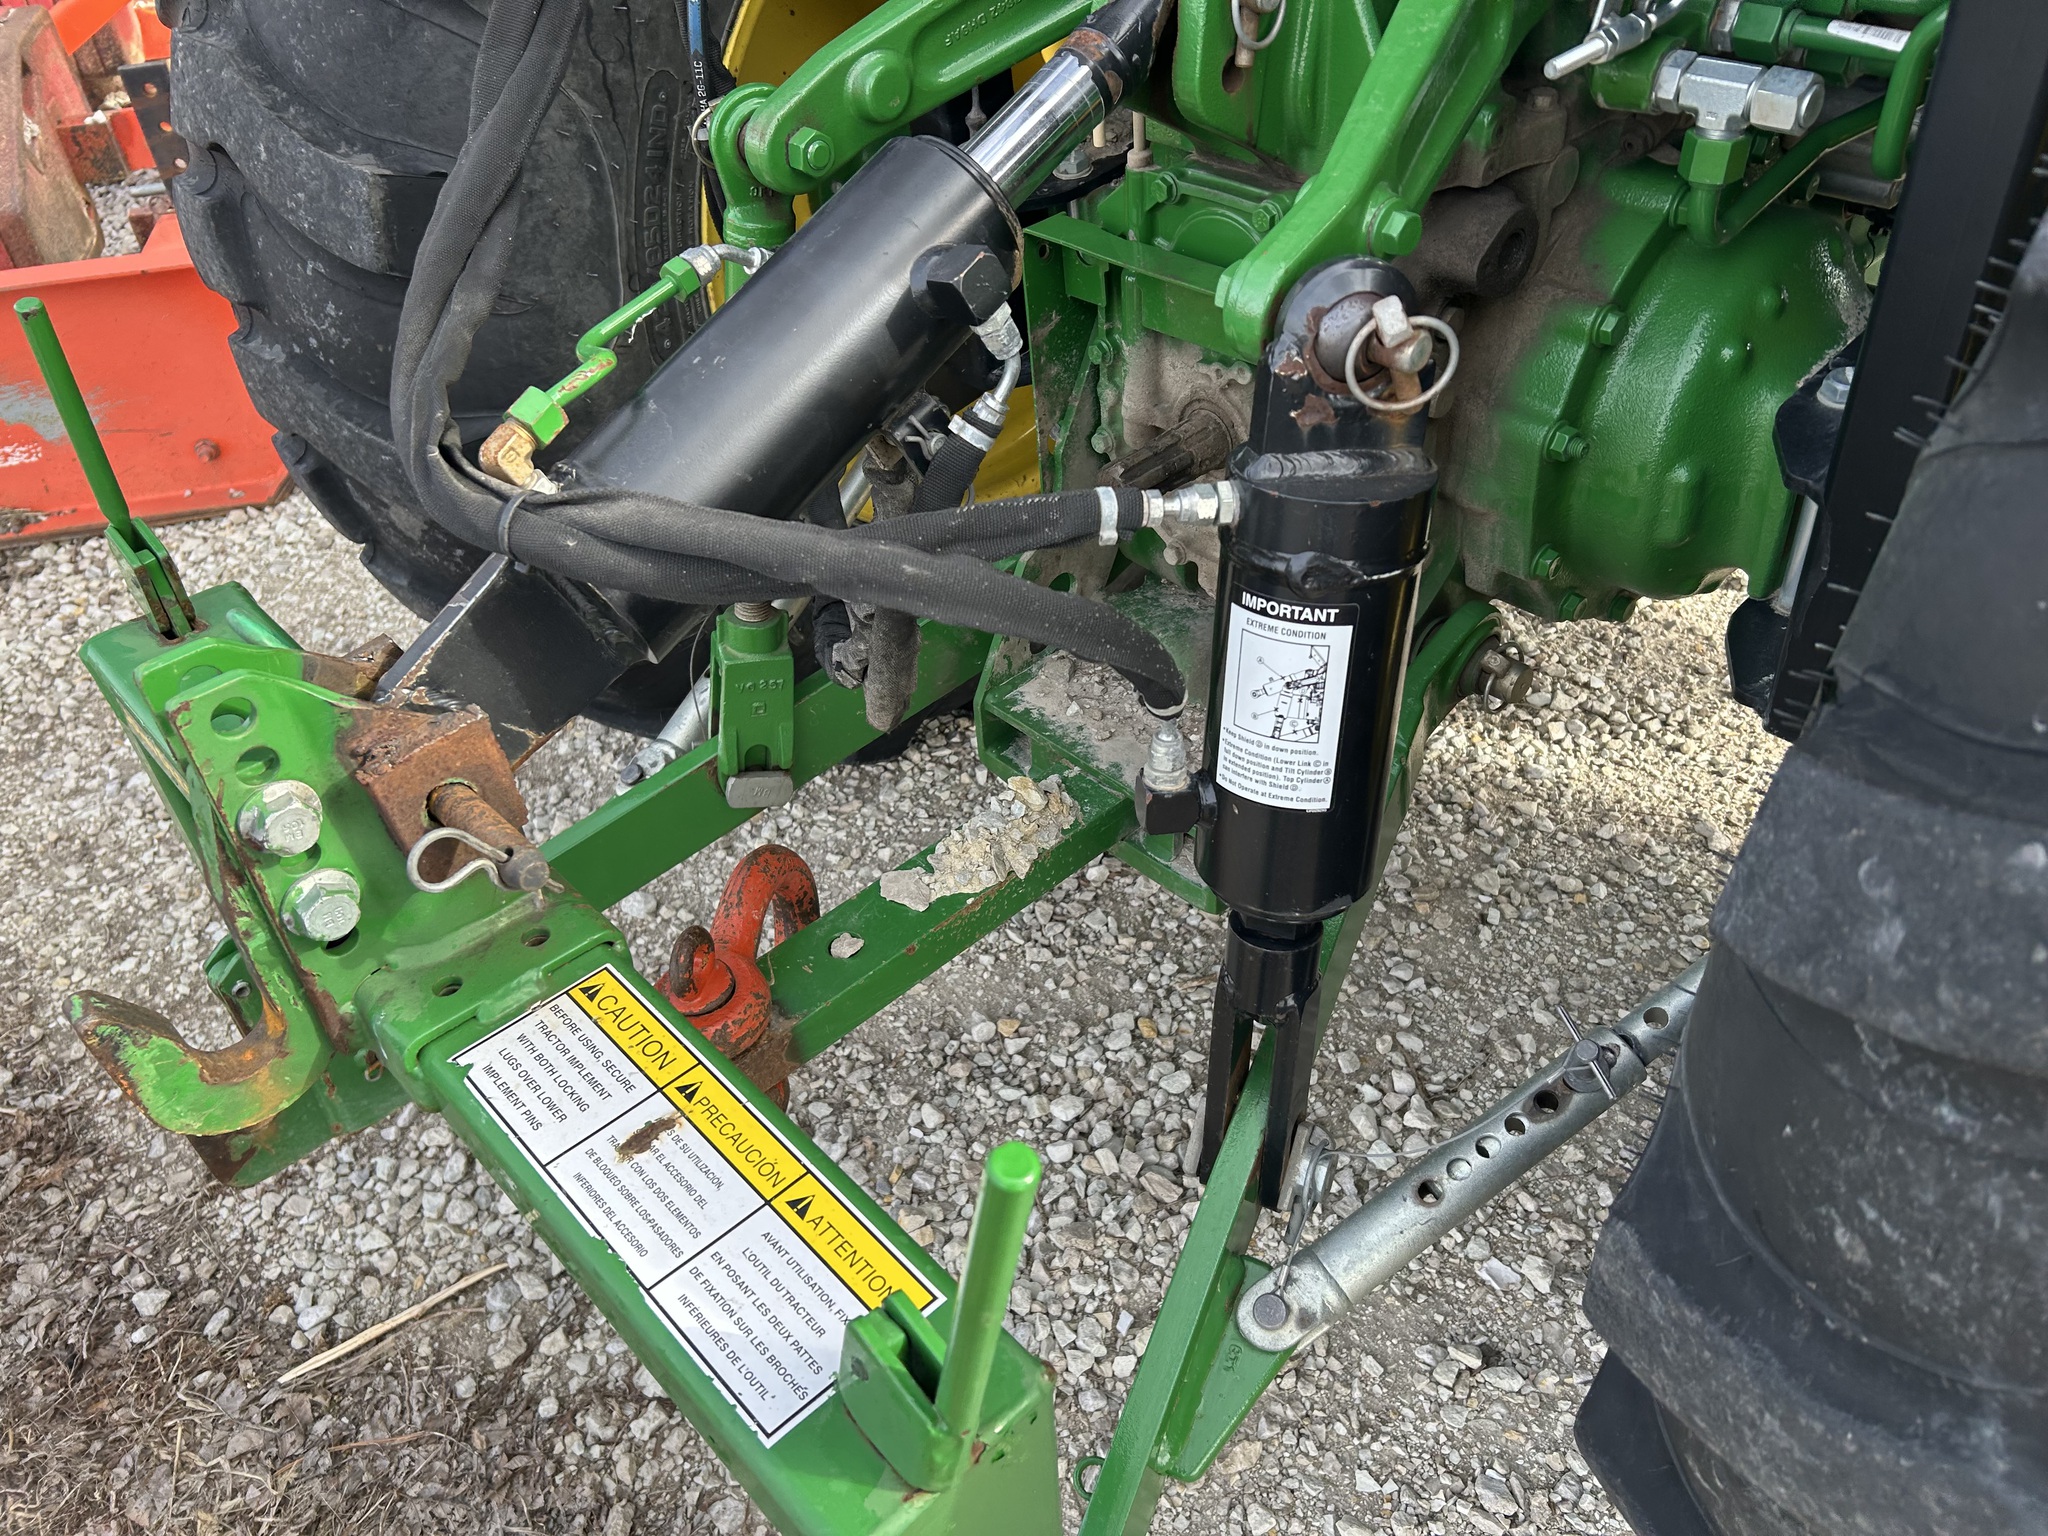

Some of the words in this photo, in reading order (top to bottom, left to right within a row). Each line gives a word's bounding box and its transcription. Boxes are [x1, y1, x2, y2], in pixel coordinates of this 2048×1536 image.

[1241, 591, 1340, 623] IMPORTANT
[1246, 617, 1279, 634] EXTREME
[1280, 627, 1327, 640] CONDITION
[1238, 733, 1255, 746] Shield
[1271, 745, 1289, 753] down
[1244, 748, 1272, 762] Condition
[1297, 759, 1311, 767] Link
[1245, 759, 1270, 770] position
[1296, 768, 1324, 776] Cylinder
[1237, 782, 1259, 796] Operate
[1268, 792, 1294, 802] Extreme
[1254, 778, 1267, 787] with
[1268, 781, 1289, 790] Shield
[1283, 775, 1295, 783] Top
[1296, 776, 1323, 784] Cylinder
[534, 1019, 571, 1057] TRACTOR
[565, 1054, 613, 1101] IMPLEMENT
[548, 1003, 583, 1036] BEFORE
[577, 1033, 604, 1063] USING,
[601, 1059, 637, 1094] SECURE
[597, 995, 677, 1071] CAUTION
[481, 1063, 527, 1111] IMPLEMENT
[520, 1109, 543, 1131] PINS
[498, 1047, 523, 1072] LUGS
[517, 1069, 542, 1094] OVER
[536, 1091, 568, 1124] LOWER
[516, 1032, 539, 1055] WITH
[533, 1052, 559, 1077] BOTH
[552, 1074, 590, 1113] LOCKING
[671, 1133, 684, 1146] DE
[679, 1142, 693, 1155] SU
[692, 1095, 787, 1189] PRECAUCIÓN
[572, 1171, 608, 1209] INFERIORES
[602, 1206, 617, 1223] DEL
[612, 1219, 649, 1258] ACCESORIO
[584, 1147, 598, 1160] DE
[592, 1156, 622, 1187] BLOQUEO
[616, 1184, 641, 1209] SOBRE
[634, 1204, 652, 1221] LOS
[645, 1217, 684, 1259] PASADORES
[629, 1161, 647, 1178] CON
[641, 1174, 658, 1190] LOS
[652, 1186, 670, 1203] DOS
[664, 1199, 702, 1240] ELEMENTOS
[655, 1152, 667, 1165] EL
[662, 1161, 698, 1197] ACCESORIO
[692, 1194, 708, 1210] DEL
[688, 1266, 705, 1281] DE
[699, 1278, 738, 1319] FIXATION
[733, 1316, 754, 1339] SUR
[749, 1335, 770, 1356] LES
[710, 1250, 726, 1266] EN
[721, 1263, 757, 1299] POSANT
[751, 1296, 771, 1317] LES
[767, 1314, 794, 1343] DEUX
[789, 1339, 824, 1376] PATTES
[741, 1246, 772, 1281] L'OUTIL
[769, 1277, 786, 1293] DU
[781, 1289, 826, 1339] TRACTEUR
[786, 1256, 836, 1312] UTILISATION,
[832, 1307, 852, 1326] FIX
[725, 1349, 742, 1367] DE
[737, 1363, 773, 1402] L'OUTIL
